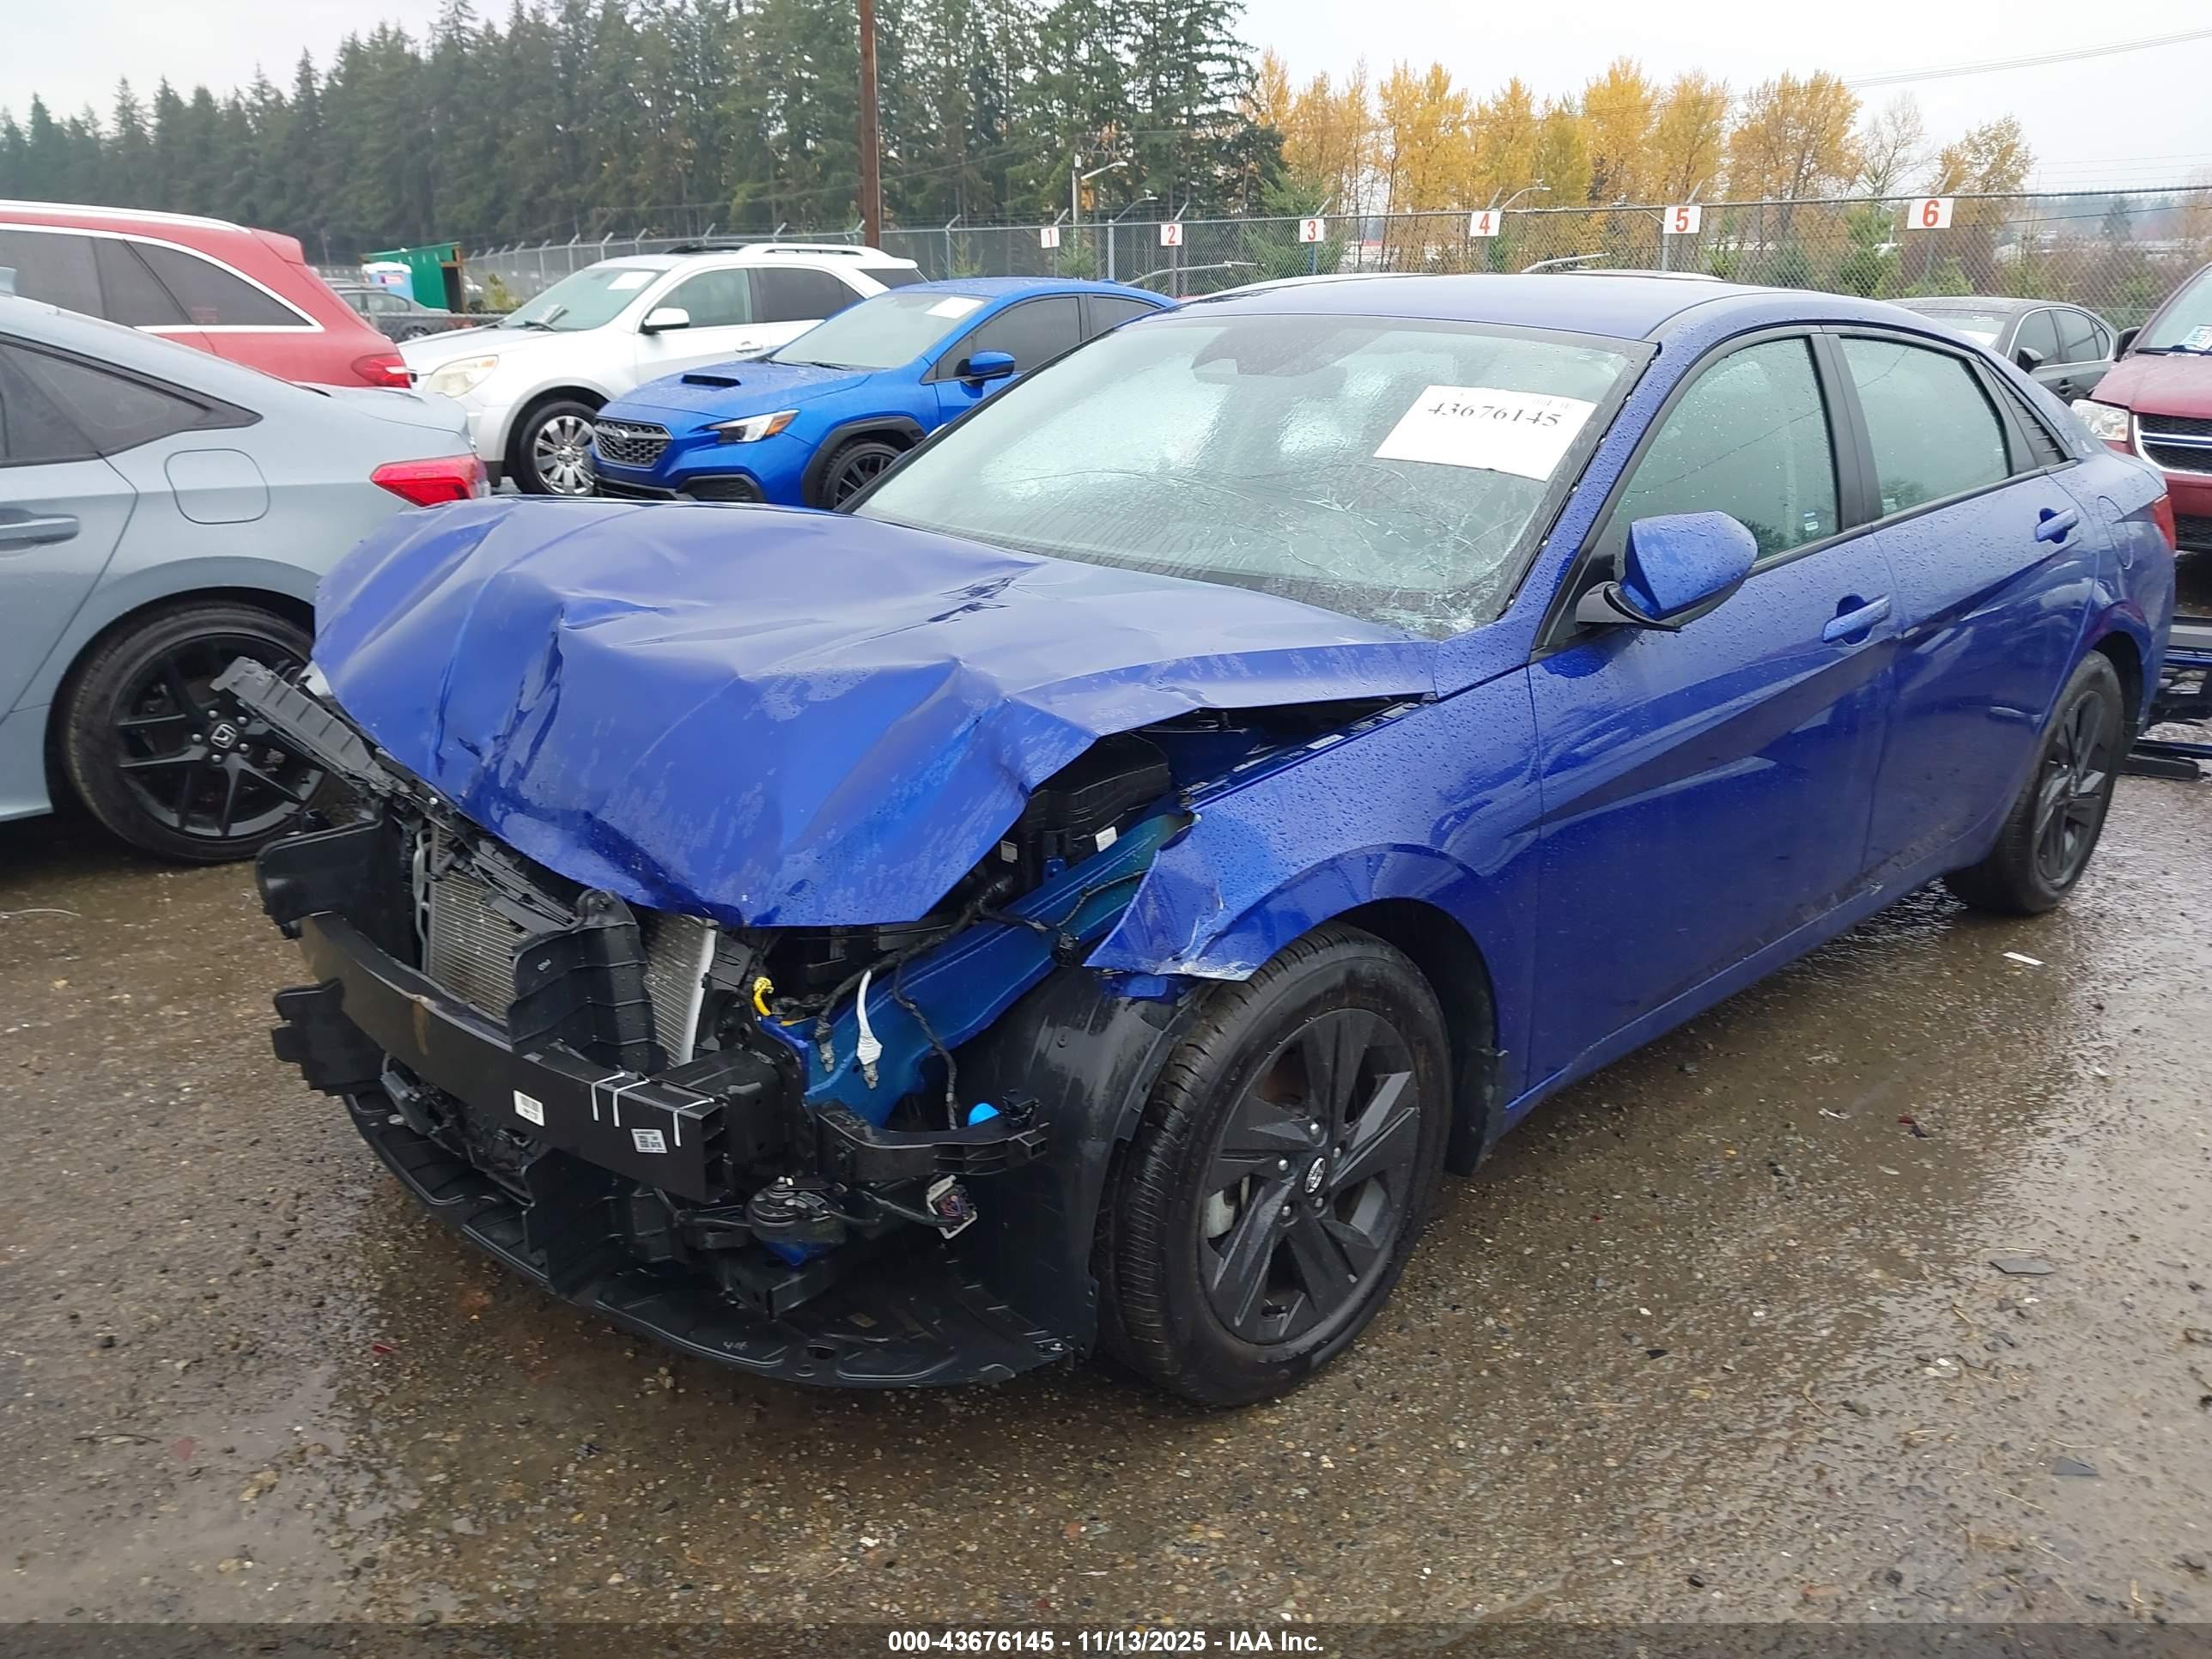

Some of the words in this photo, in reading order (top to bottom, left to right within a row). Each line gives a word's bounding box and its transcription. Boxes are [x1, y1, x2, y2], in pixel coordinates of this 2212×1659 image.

[1480, 213, 1491, 235] 4
[1674, 207, 1690, 233] 5
[1922, 199, 1940, 228] 6
[1047, 228, 1054, 246] 1
[1167, 226, 1176, 245] 2
[1307, 221, 1317, 241] 3
[1428, 402, 1563, 427] 43676145
